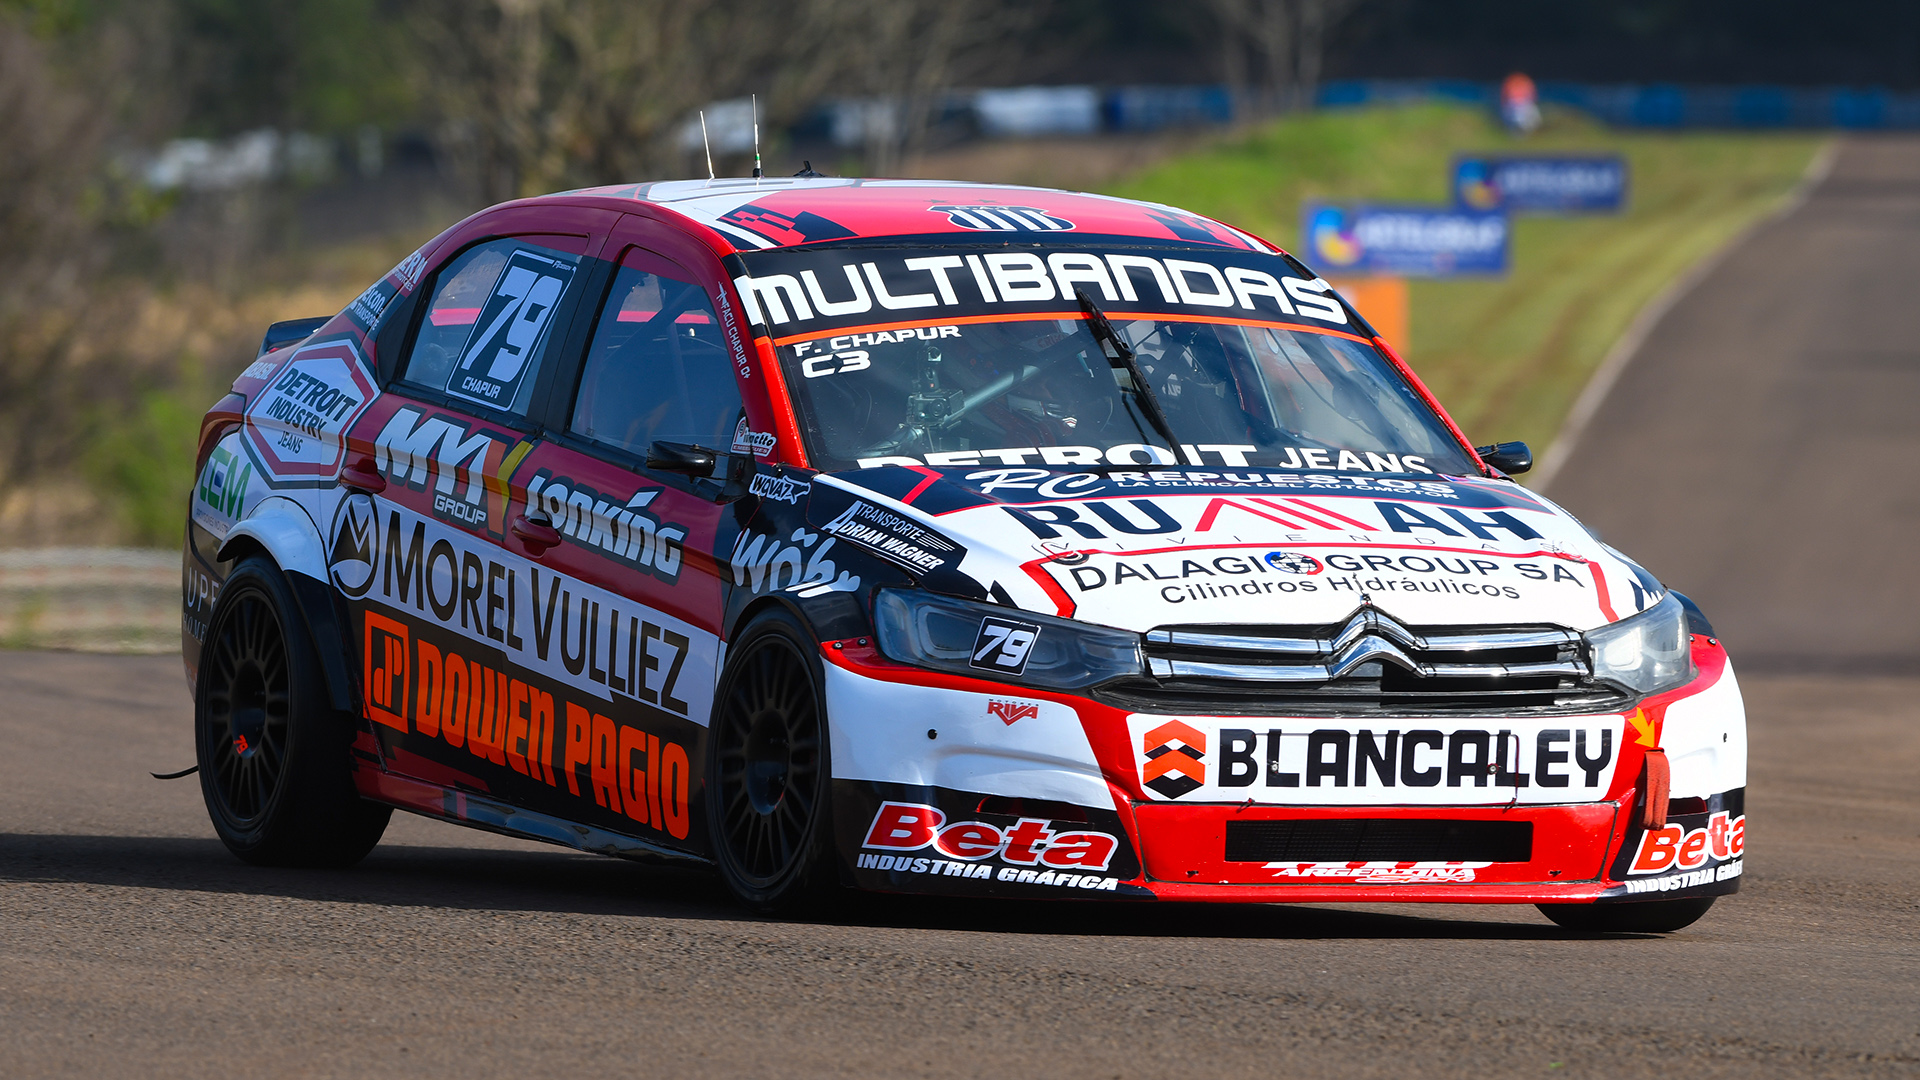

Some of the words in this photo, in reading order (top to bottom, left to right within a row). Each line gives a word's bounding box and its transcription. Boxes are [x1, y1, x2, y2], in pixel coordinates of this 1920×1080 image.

[733, 253, 1348, 326] MULTIBANDAS
[461, 265, 563, 383] 79
[721, 302, 735, 327] FACU
[728, 326, 747, 367] CHAPUR
[793, 341, 822, 357] F.
[829, 325, 962, 350] CHAPUR
[802, 350, 871, 378] C3
[274, 367, 358, 422] DETROIT
[461, 376, 501, 399] CHAPUR
[266, 396, 327, 441] INDUSTRY
[277, 430, 303, 454] JEANS
[1279, 447, 1433, 474] JEANS
[965, 468, 1106, 498] RC
[1107, 472, 1456, 495] REPUESTOS
[1302, 482, 1460, 499] AUTOMOTOR
[434, 494, 486, 525] GROUP
[857, 502, 925, 541] TRANSPORTE
[821, 500, 884, 549] ADRIAN
[882, 534, 945, 570] WAGNER
[1160, 575, 1318, 604] Cilindros
[1326, 576, 1520, 600] Hidráulicos
[1324, 554, 1500, 576] GROUP
[1513, 562, 1585, 588] SA
[383, 510, 523, 651] MOREL
[530, 566, 690, 716] VULLIEZ
[973, 624, 1035, 667] 79
[987, 701, 1038, 726] RIVA
[416, 638, 557, 788] DOWEN
[563, 701, 690, 840] PAGIO
[1217, 728, 1613, 788] BLANCALEY
[861, 800, 1119, 871] Beta
[1627, 810, 1745, 875] Beta
[857, 853, 993, 880] INDUSTRIA
[996, 869, 1120, 891] GRÁFICA
[1624, 867, 1715, 894] INDUSTRIA
